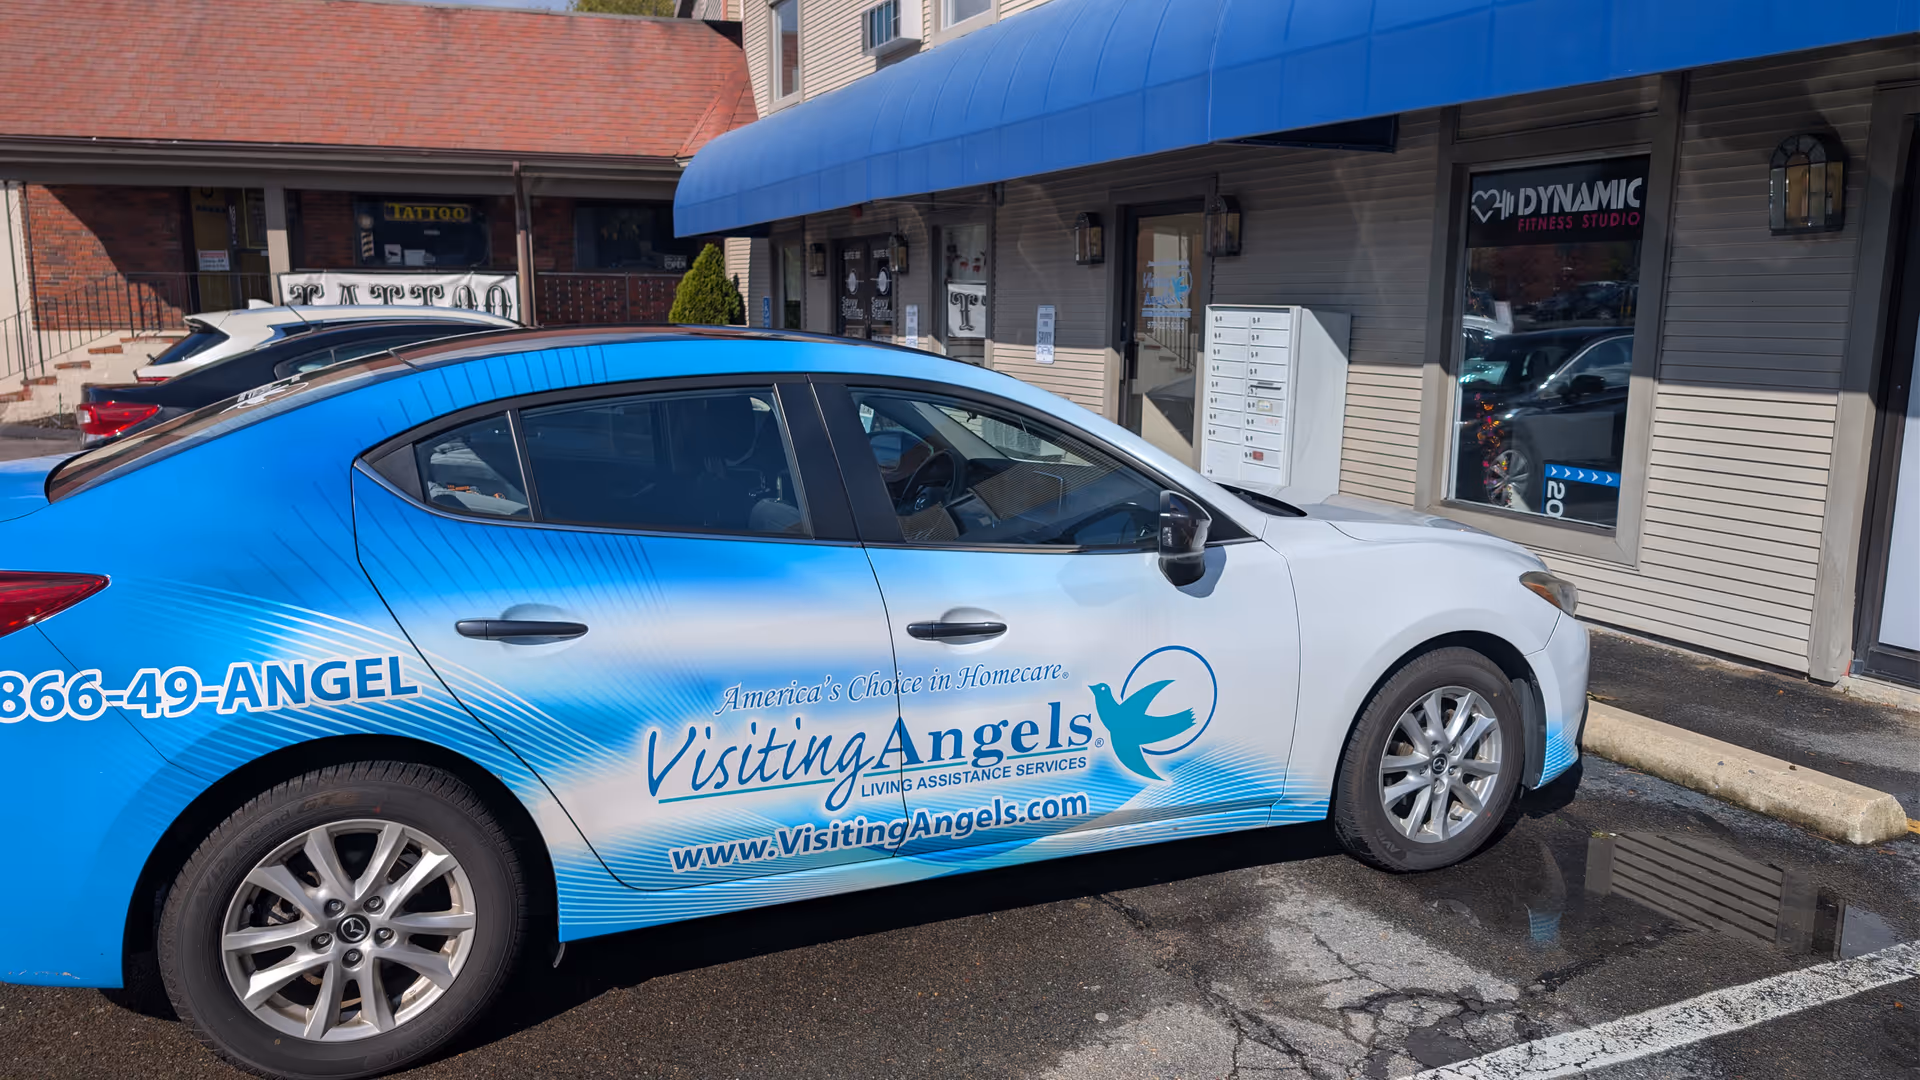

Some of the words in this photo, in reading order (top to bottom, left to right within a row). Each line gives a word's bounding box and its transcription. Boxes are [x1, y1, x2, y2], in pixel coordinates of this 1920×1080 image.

[386, 202, 466, 220] TATTOO
[1518, 177, 1643, 216] DYNAMIC
[1517, 215, 1574, 233] FITNESS
[1581, 211, 1641, 229] STUDIO
[950, 291, 986, 332] T
[1546, 480, 1565, 518] 20
[0, 655, 421, 722] 866-49-ANGEL
[713, 675, 841, 716] America's
[848, 670, 922, 702] Choice
[929, 667, 951, 692] in
[648, 717, 875, 811] Visiting
[871, 701, 1093, 769] Angels
[861, 778, 913, 797] LIVING
[917, 767, 1011, 790] ASSISTANCE
[1016, 756, 1087, 777] SERVICES
[669, 793, 1089, 872] www.VisitingAngels.com
